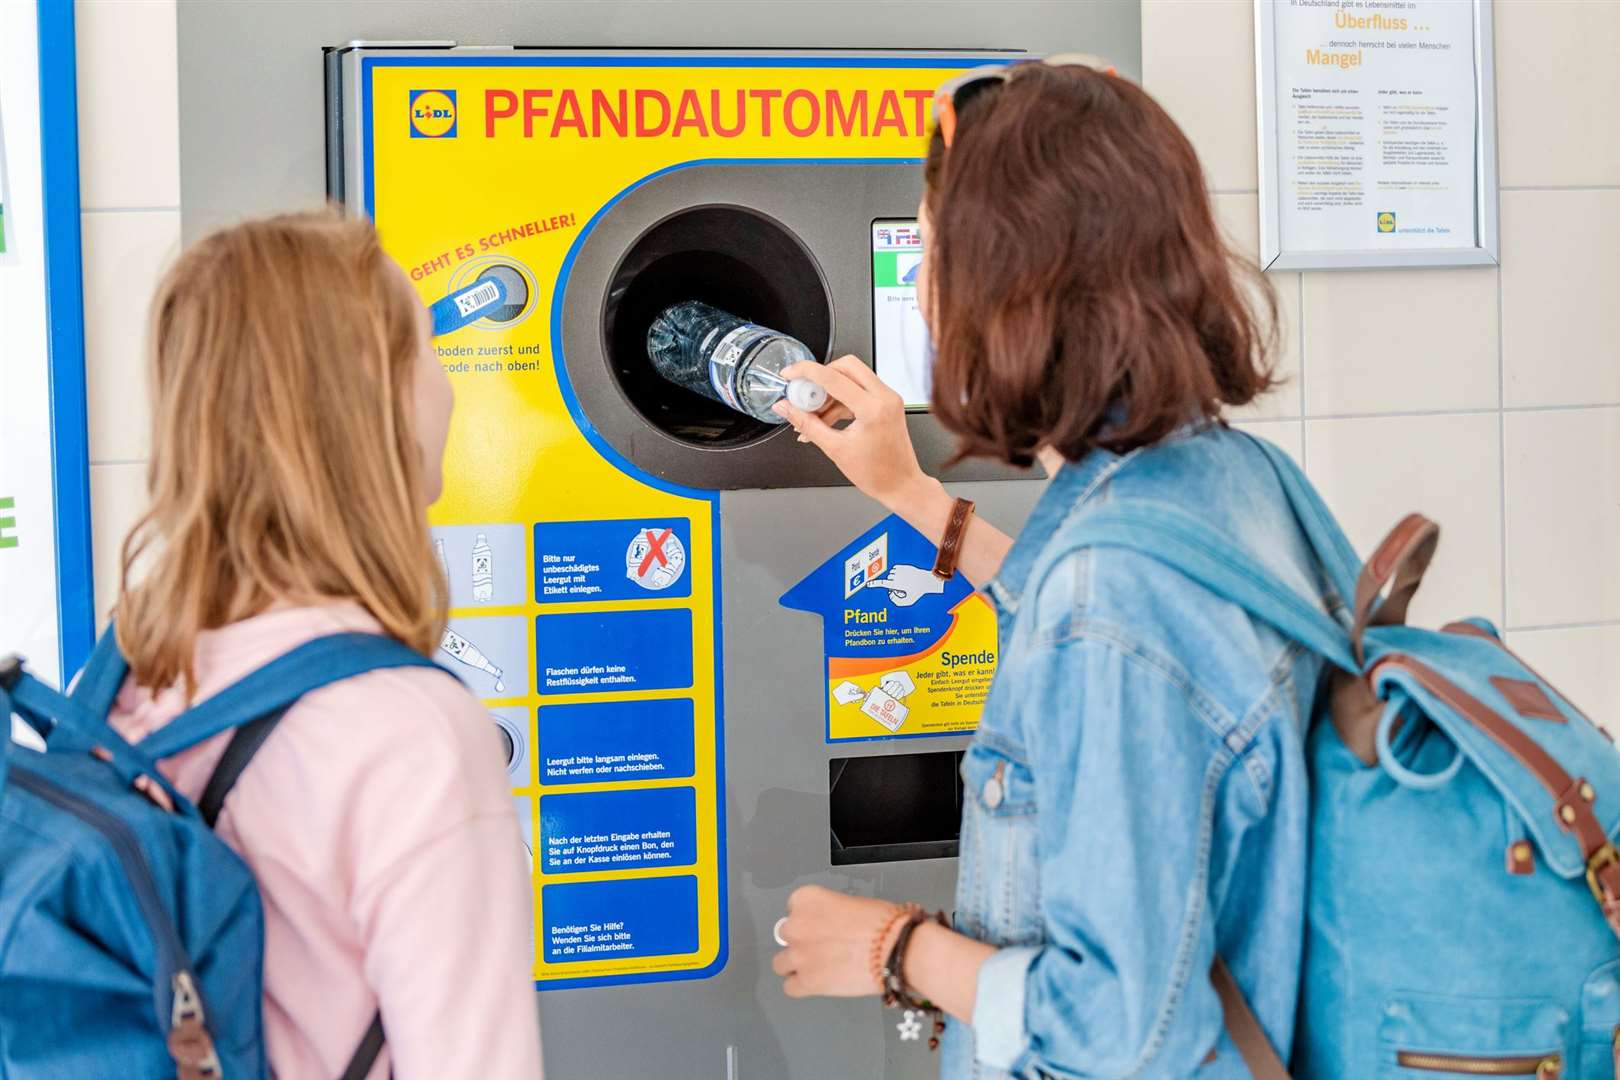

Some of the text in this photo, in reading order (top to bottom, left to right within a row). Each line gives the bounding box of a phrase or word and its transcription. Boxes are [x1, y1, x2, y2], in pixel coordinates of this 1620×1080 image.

[1341, 0, 1354, 9] gibt
[1365, 0, 1406, 9] Lebensmittel
[1335, 9, 1408, 30] Überfluss
[1329, 40, 1357, 48] dennoch
[1358, 40, 1385, 49] herrscht
[1386, 41, 1397, 49] bei
[1398, 41, 1417, 49] vielen
[1418, 42, 1451, 50] Menschen
[1306, 49, 1362, 69] Mangel
[485, 89, 934, 138] PFANDAUTOMAT
[410, 212, 577, 282] GEHT ES SCHNELLER!
[434, 343, 540, 357] boden zuerst und
[441, 359, 540, 373] code nach oben!
[543, 554, 561, 563] Bitte
[543, 564, 600, 574] unbeschädigtes
[543, 574, 586, 585] Leergut mit
[544, 585, 602, 595] Etikett einlegen.
[844, 608, 887, 624] Pfand
[845, 629, 871, 638] Drücken
[873, 628, 884, 636] Sie
[885, 627, 900, 636] hier,
[913, 626, 931, 634] Ihren
[845, 638, 876, 647] Pfandbon
[887, 637, 915, 645] erhalten.
[941, 650, 995, 668] Spende
[546, 664, 626, 676] Flaschen dürfen keine
[916, 671, 934, 679] Jeder
[936, 670, 951, 680] gibt,
[546, 675, 637, 687] Restflüssigkeit enthalten.
[547, 753, 660, 767] Leergut bitte langsam einlegen.
[547, 763, 665, 776] Nicht werfen oder nachschieben.
[549, 831, 671, 845] Nach der letzten Eingabe erhalten
[549, 840, 674, 856] Sie auf Knopfdruck einen Bon, den
[549, 851, 672, 866] Sie an der Kasse einlösen können.
[552, 921, 624, 935] Benötigen Sie Hilfe?
[552, 932, 631, 945] Wenden Sie sich bitte
[552, 942, 635, 956] an die Filialmitarbeiter.
